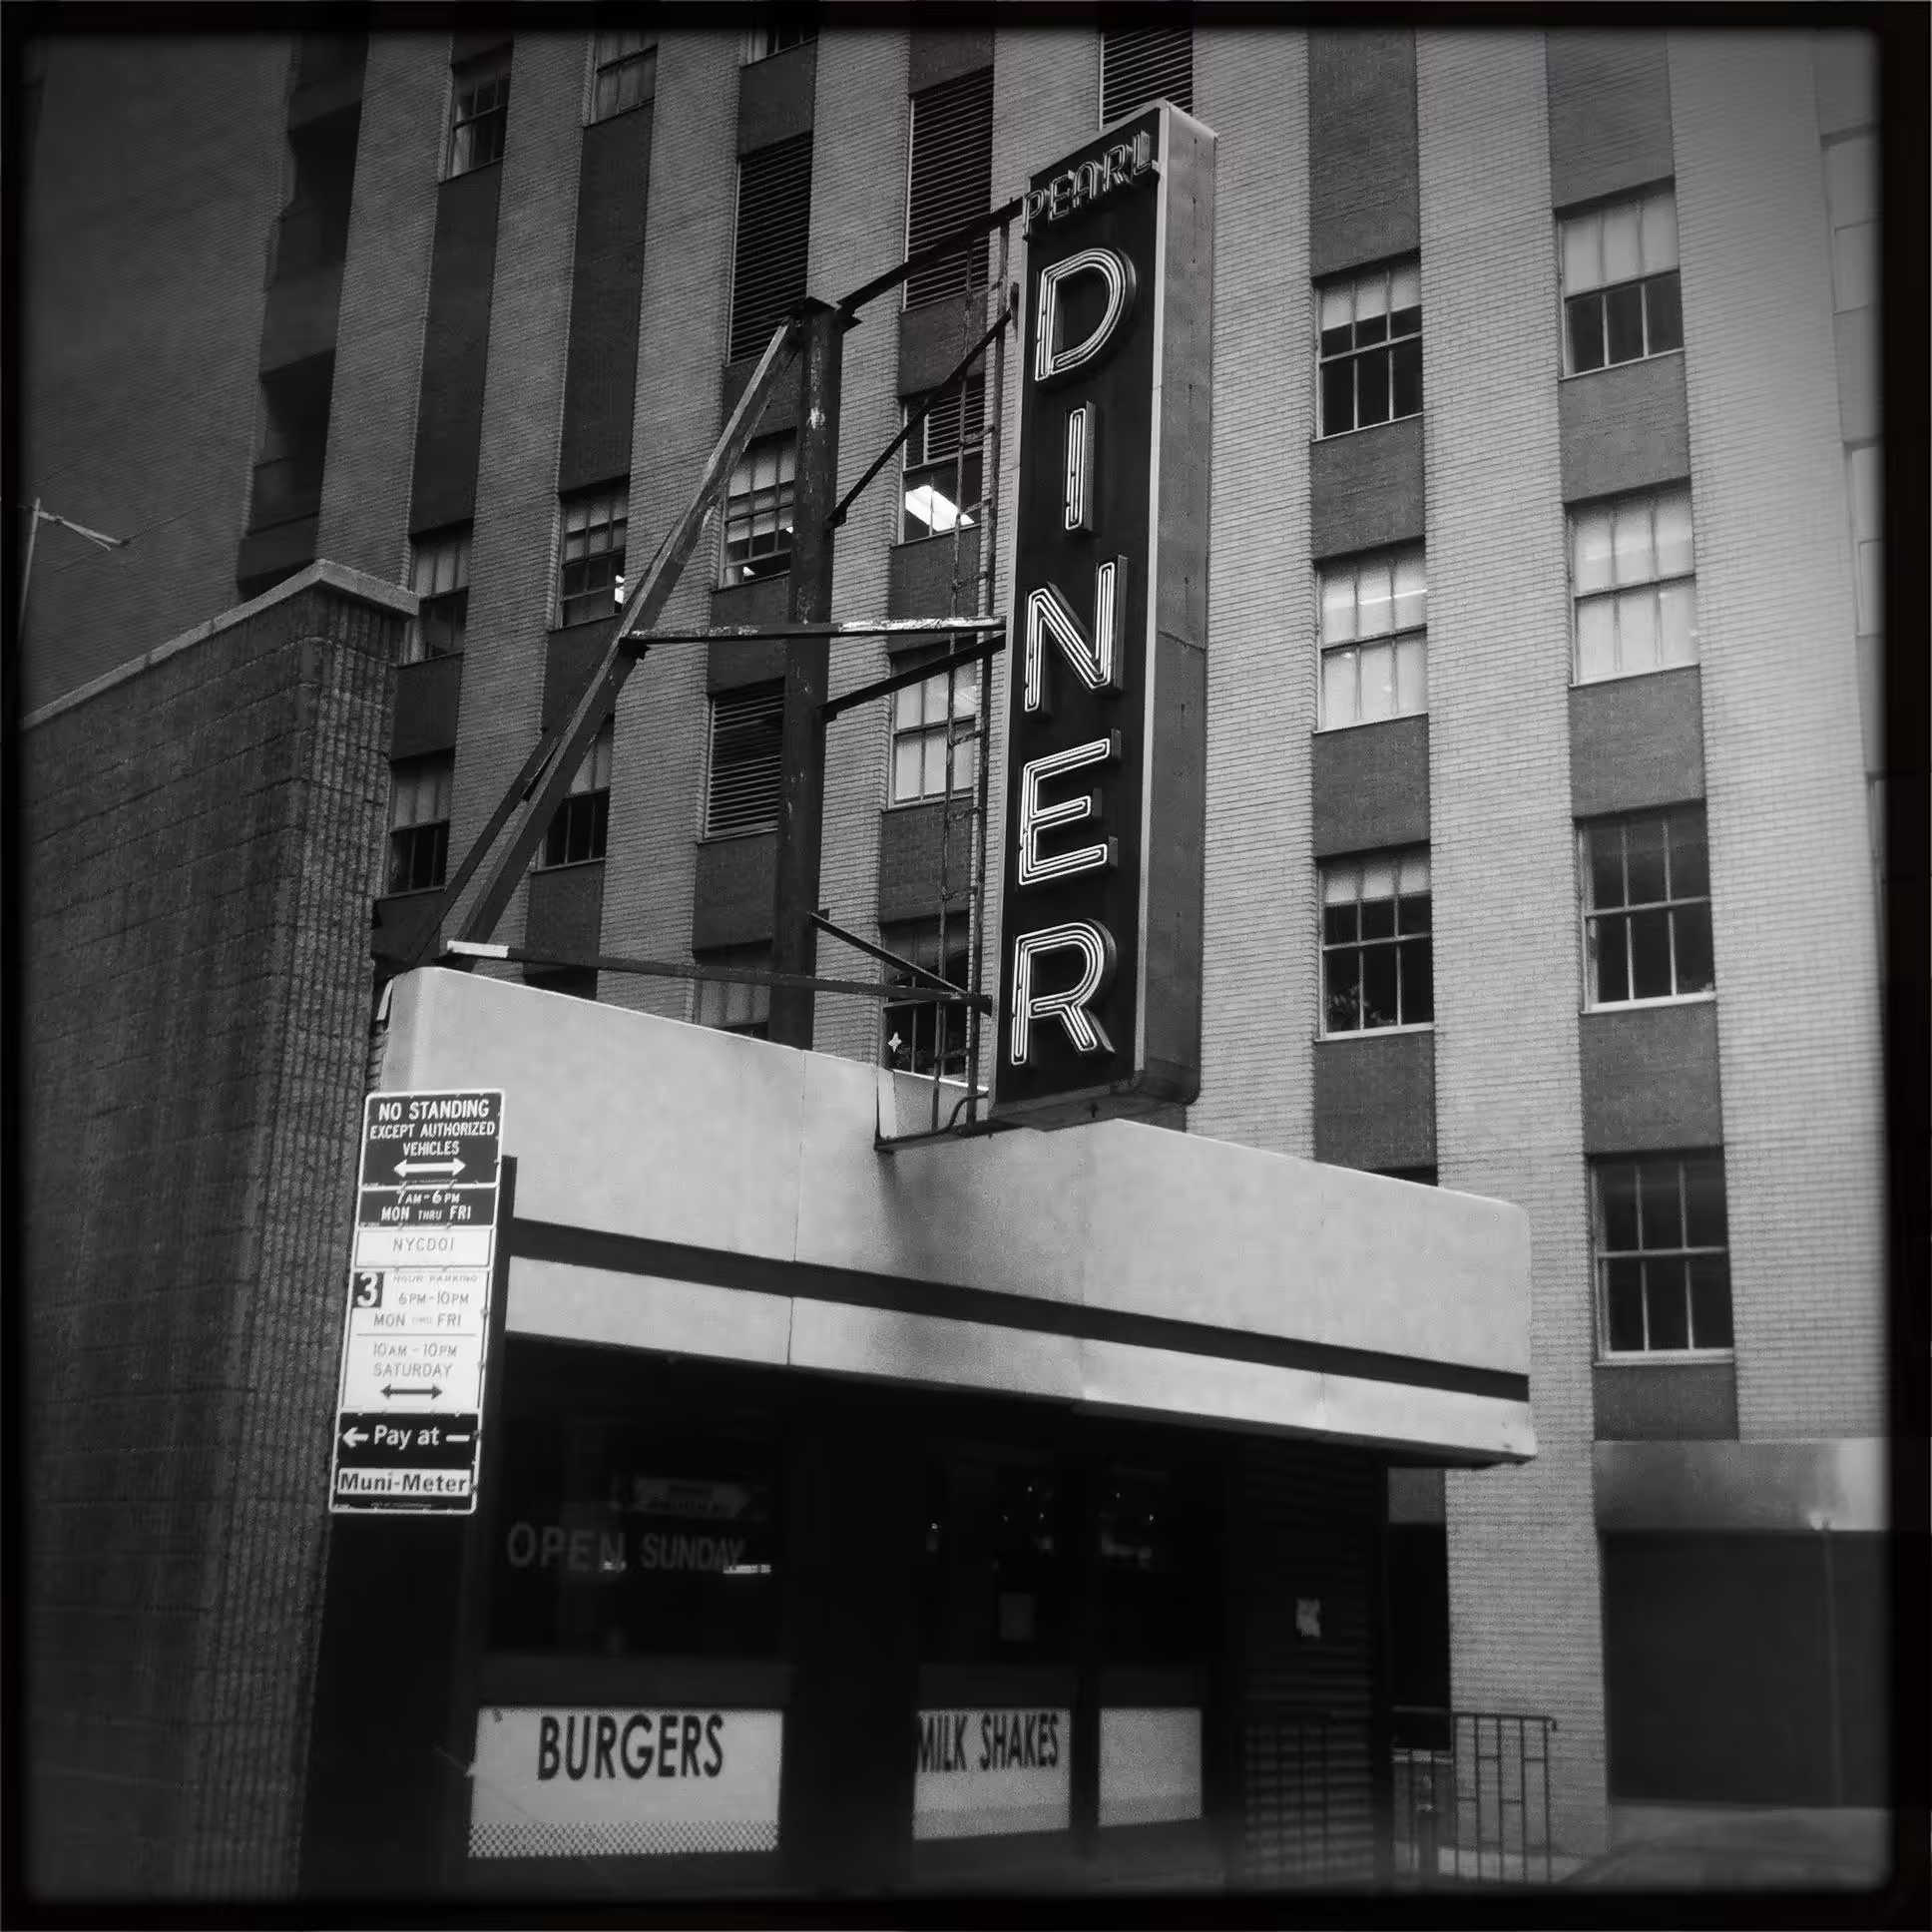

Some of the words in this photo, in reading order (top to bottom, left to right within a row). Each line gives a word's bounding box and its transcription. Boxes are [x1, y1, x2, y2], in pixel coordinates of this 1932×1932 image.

[1022, 131, 1152, 238] PEARL
[1011, 247, 1135, 1068] DINER
[378, 1102, 402, 1122] NO
[408, 1100, 490, 1121] STANDING
[369, 1124, 415, 1140] EXCEPT
[419, 1121, 496, 1138] AUTHORIZED
[402, 1141, 460, 1157] VEHICLES
[380, 1206, 410, 1221] MON
[417, 1209, 442, 1220] THRU
[449, 1205, 472, 1220] FRI
[356, 1272, 378, 1308] 3
[373, 1312, 406, 1327] MON
[437, 1312, 462, 1327] FRI
[372, 1362, 453, 1378] SATURDAY
[373, 1424, 412, 1451] Pay
[417, 1426, 440, 1446] at
[339, 1471, 468, 1493] Muni-Meter
[507, 1521, 626, 1573] OPEN
[640, 1532, 746, 1572] SUNDAY
[537, 1713, 724, 1780] BURGERS
[915, 1713, 968, 1772] MILK
[978, 1712, 1060, 1771] SHAKES
